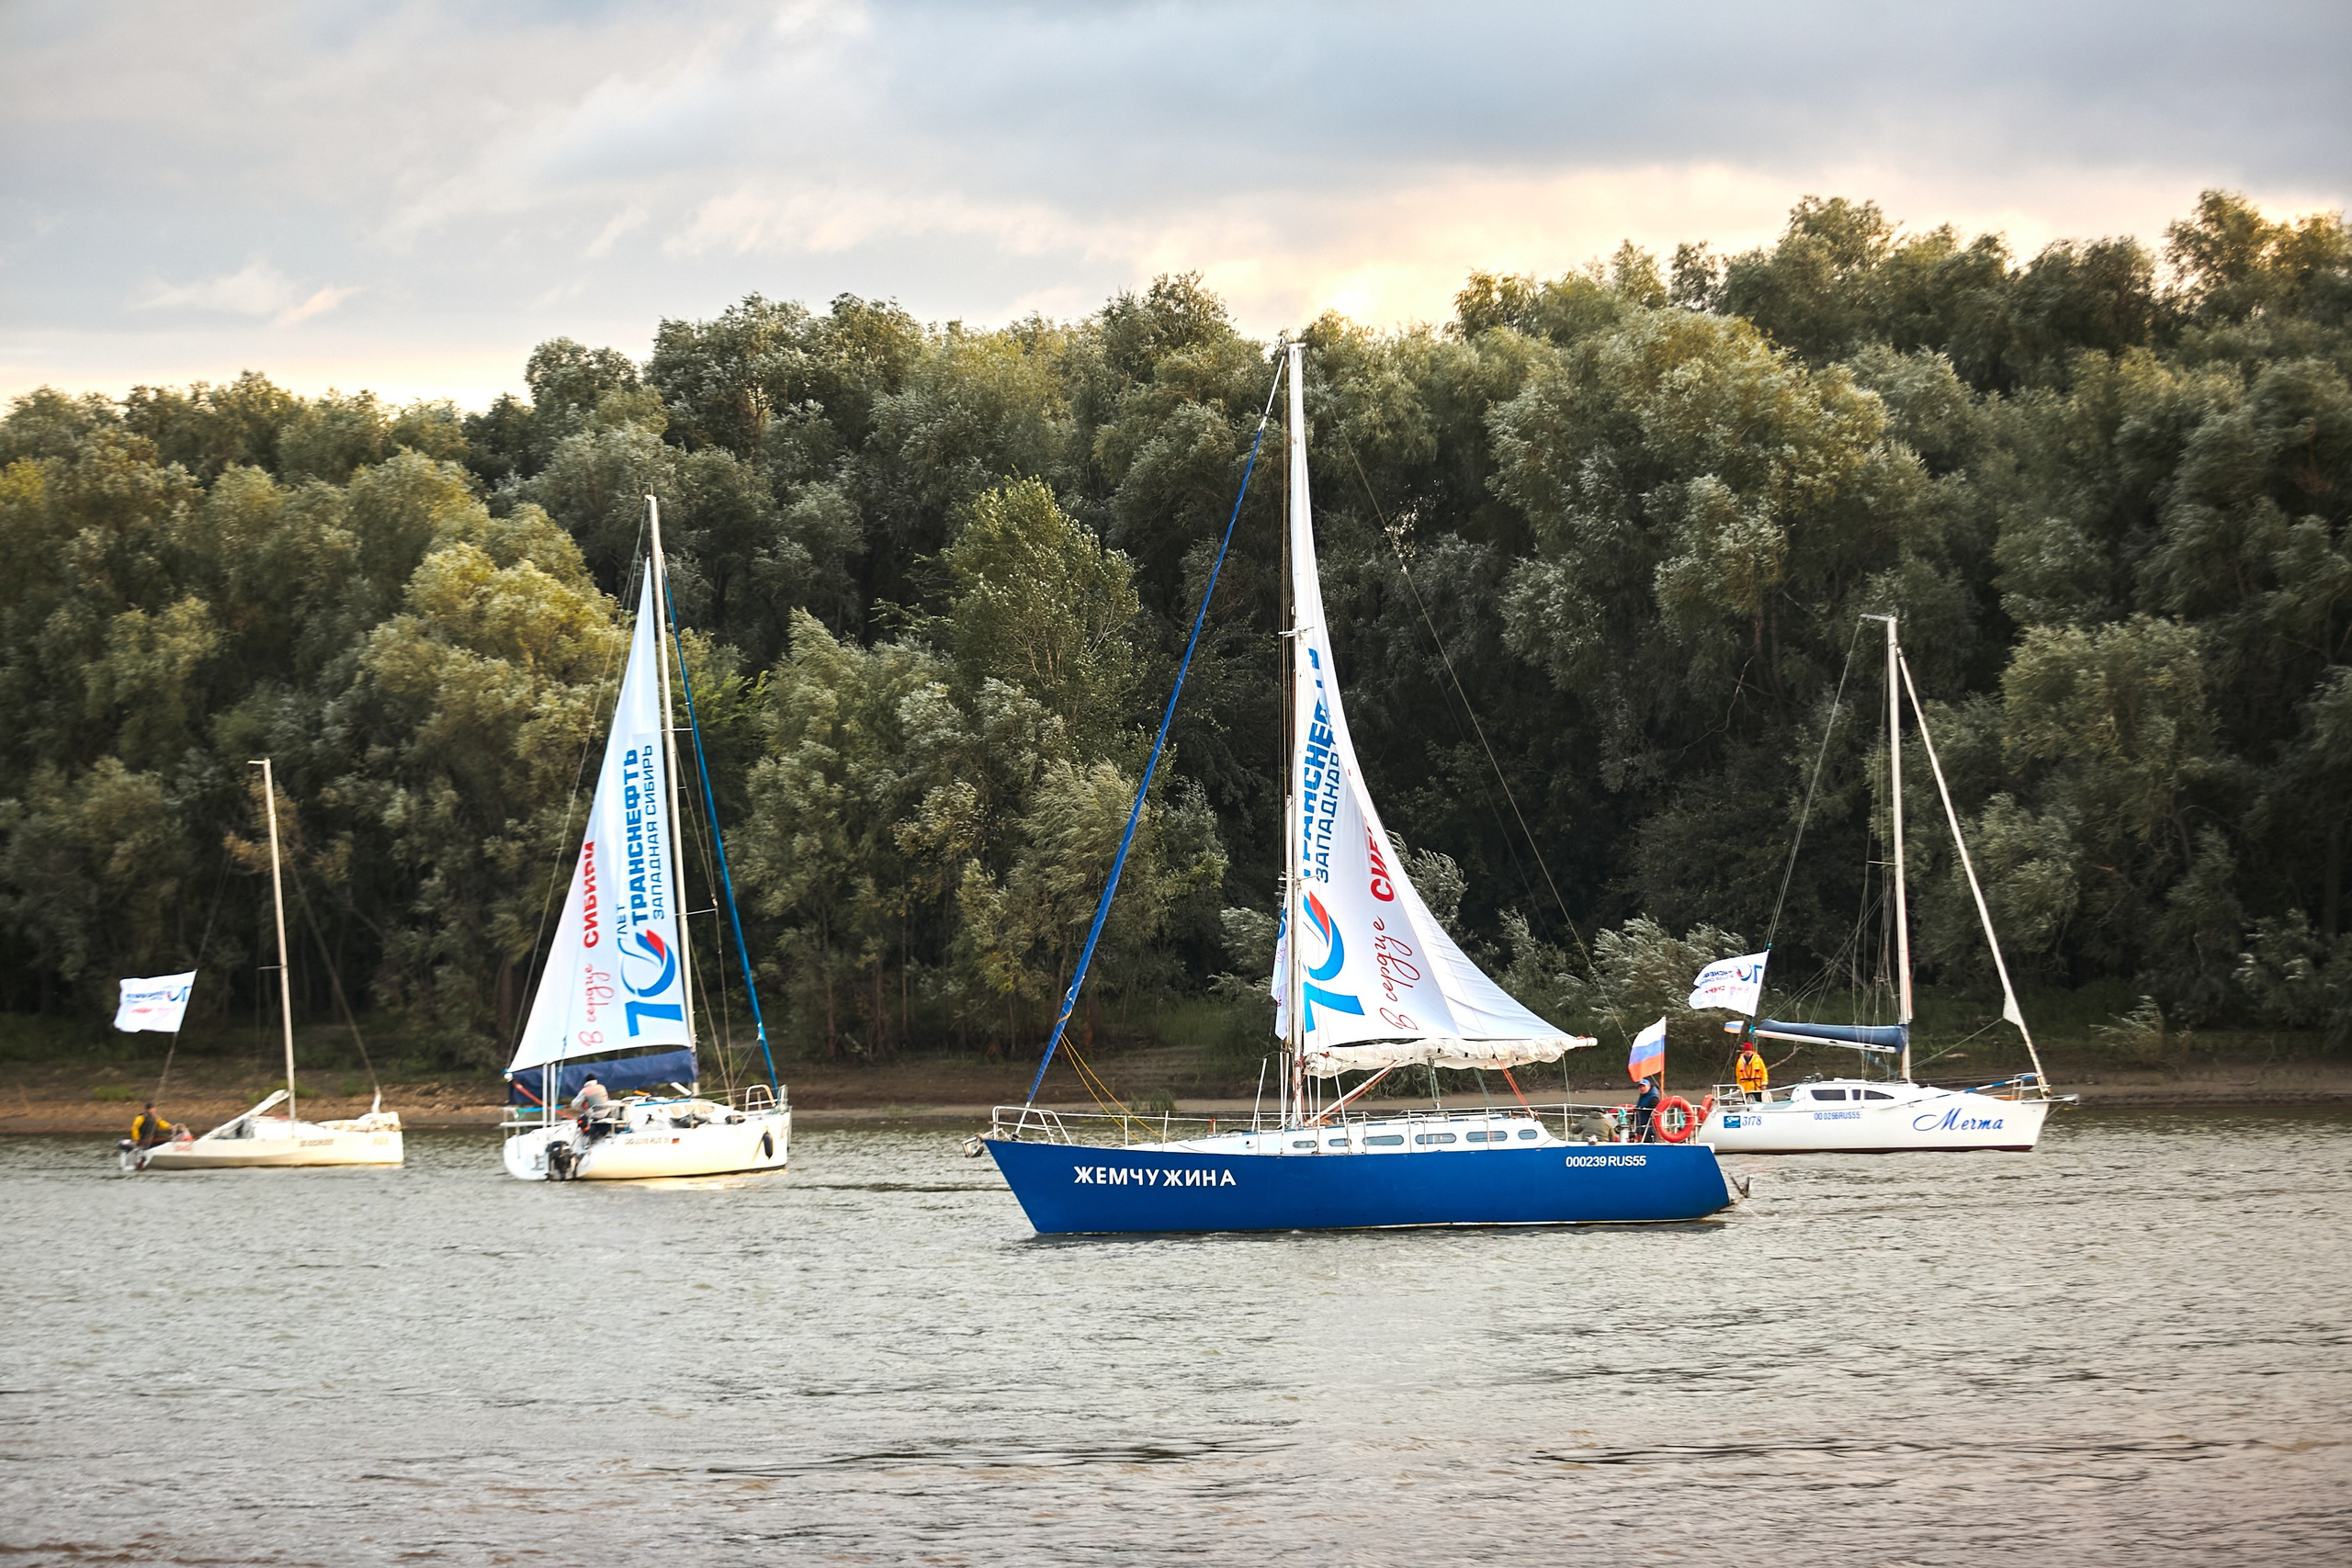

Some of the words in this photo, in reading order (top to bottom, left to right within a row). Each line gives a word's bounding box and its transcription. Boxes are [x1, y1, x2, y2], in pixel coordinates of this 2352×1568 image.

[642, 745, 656, 816] СИБИРЬ
[624, 749, 649, 926] ТРАНСНЕФТЬ
[647, 821, 664, 919] ЗАПАДНАЯ
[1373, 915, 1420, 1001] сердце
[584, 964, 615, 1022] сердце
[1742, 1115, 1762, 1126] 3178
[1073, 1166, 1237, 1187] ЖЕМЧУЖИНА
[1566, 1156, 1607, 1168] 000239
[1608, 1156, 1646, 1167] RUS55
